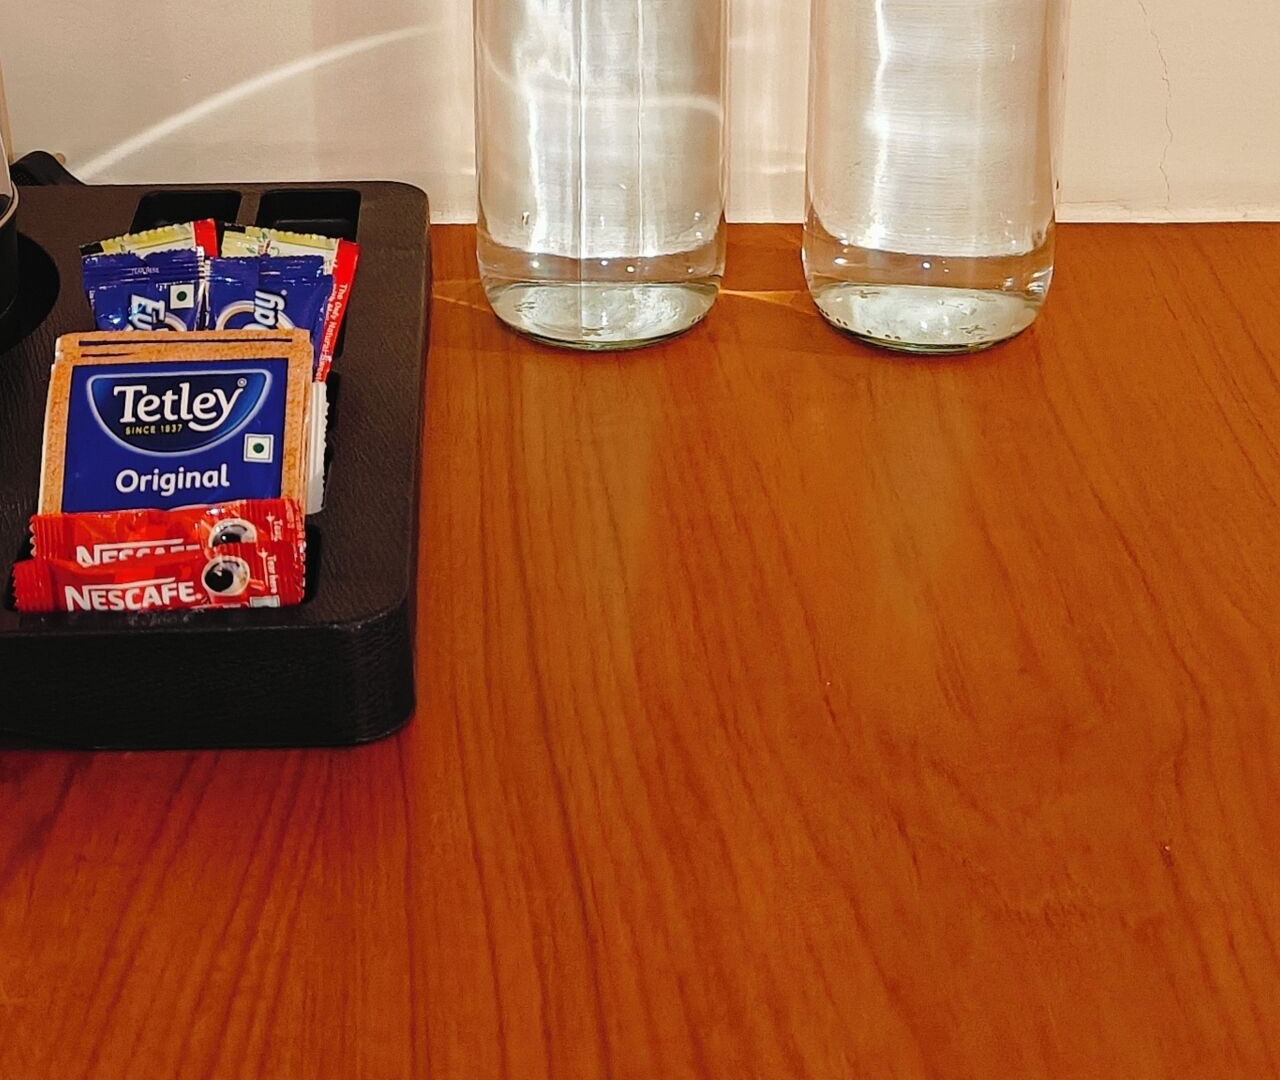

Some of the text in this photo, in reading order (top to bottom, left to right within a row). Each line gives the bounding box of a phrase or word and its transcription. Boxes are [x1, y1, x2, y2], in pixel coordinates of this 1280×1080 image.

[337, 283, 348, 299] The
[243, 290, 285, 330] ay
[113, 382, 244, 432] Tetley
[125, 425, 156, 436] SINCE
[115, 463, 230, 497] Original
